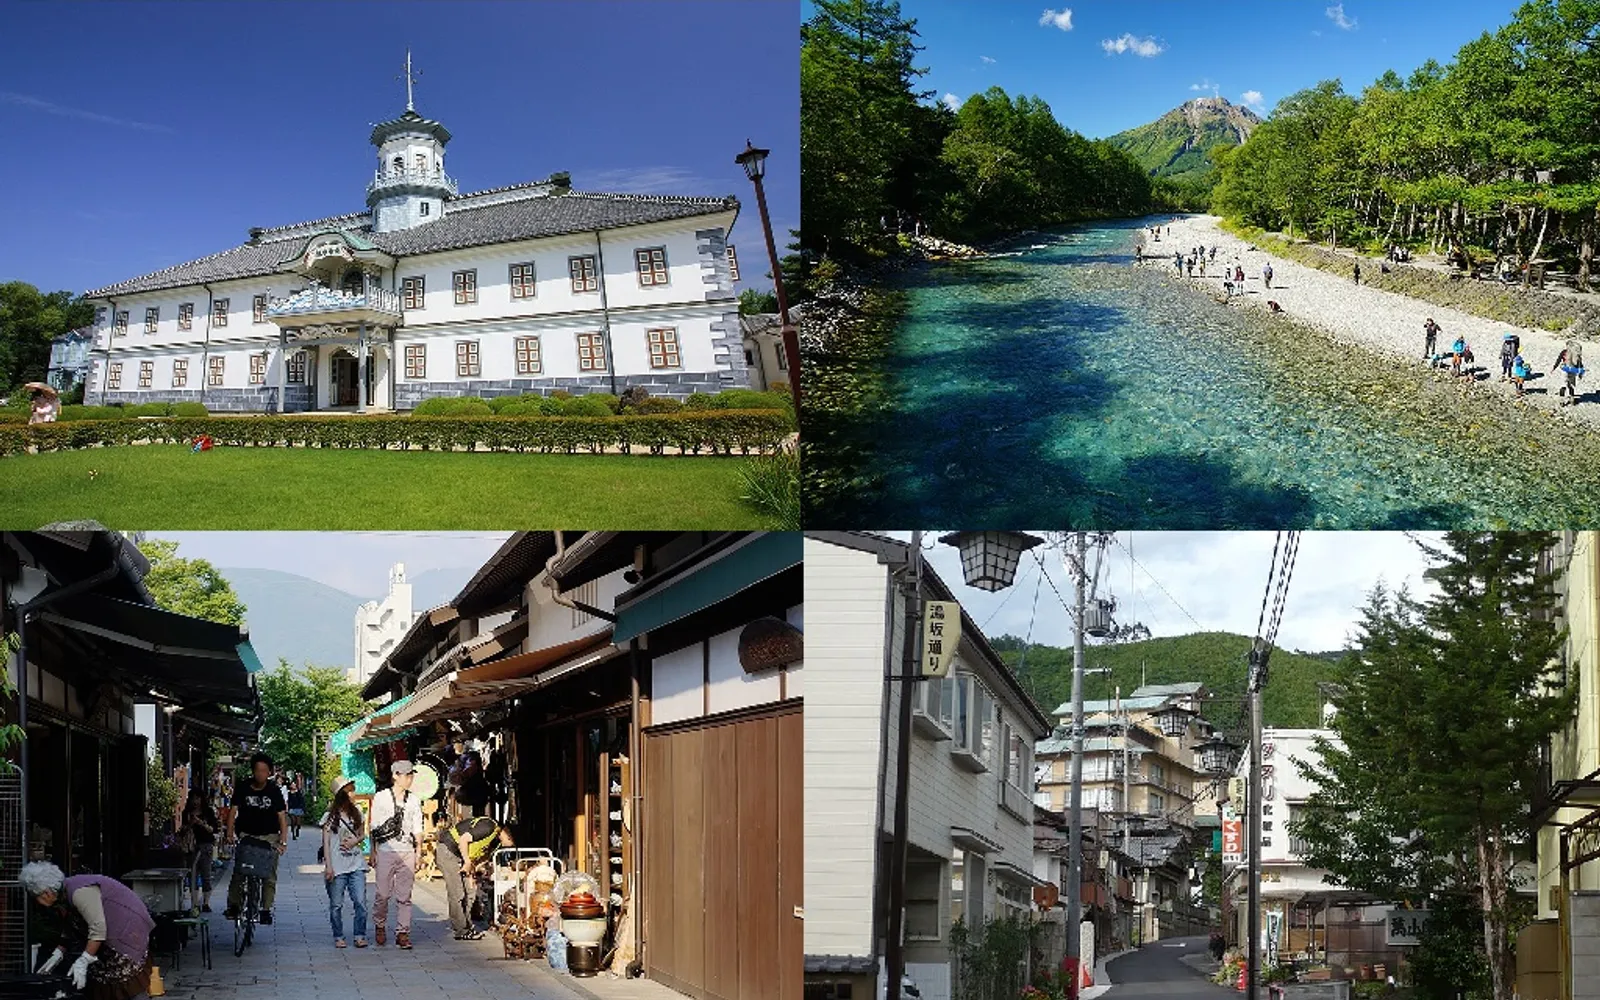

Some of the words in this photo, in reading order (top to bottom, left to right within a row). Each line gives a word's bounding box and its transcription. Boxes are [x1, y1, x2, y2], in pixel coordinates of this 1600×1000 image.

[928, 605, 945, 672] 湯坂通り
[1224, 822, 1240, 852] くすり
